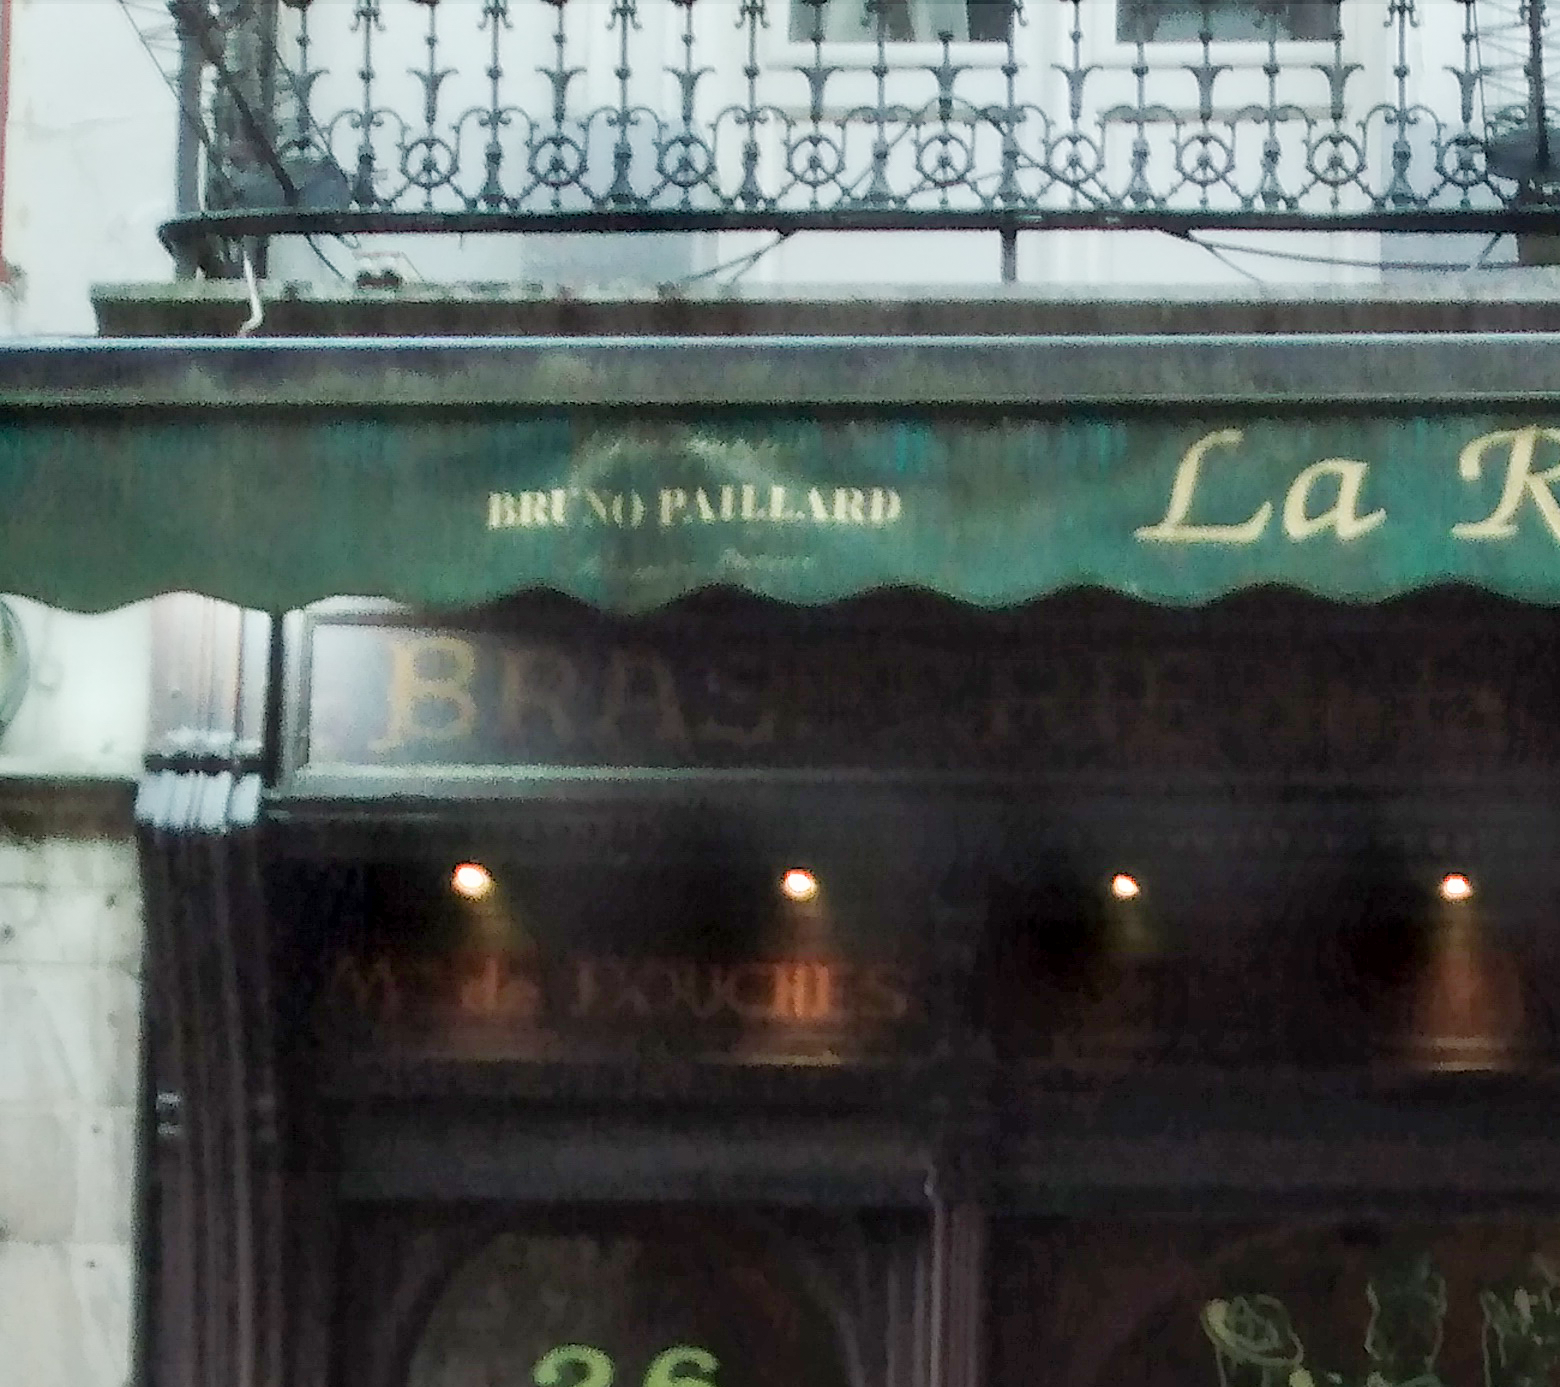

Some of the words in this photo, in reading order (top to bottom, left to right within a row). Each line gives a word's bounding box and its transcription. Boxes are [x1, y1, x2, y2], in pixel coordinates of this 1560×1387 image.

[487, 487, 646, 530] BRUNO
[659, 484, 902, 530] PAILLARD
[1133, 427, 1388, 543] La
